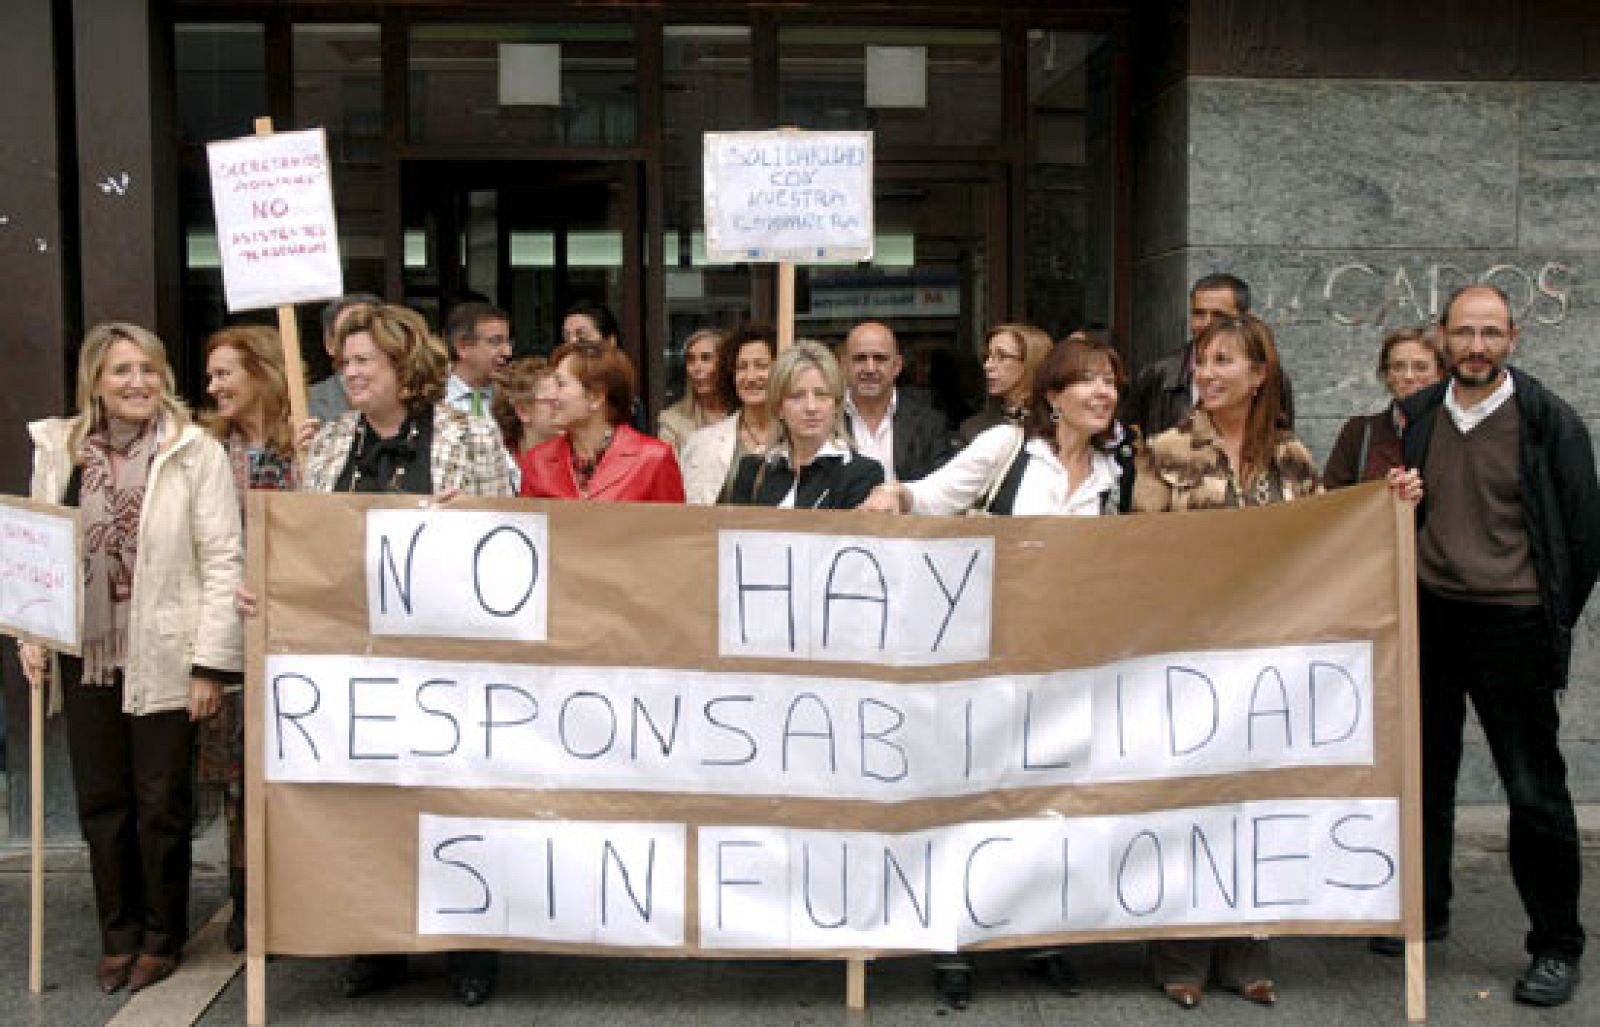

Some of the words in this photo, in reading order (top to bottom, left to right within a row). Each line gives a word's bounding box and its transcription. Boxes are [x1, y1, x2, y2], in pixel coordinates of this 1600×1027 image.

[252, 198, 289, 218] NO
[379, 522, 539, 617] NO
[735, 543, 981, 652] HAY
[272, 661, 1361, 783] RESPONSABILIDAD
[432, 835, 655, 926] SIN
[717, 813, 1395, 930] FUNCIONES
